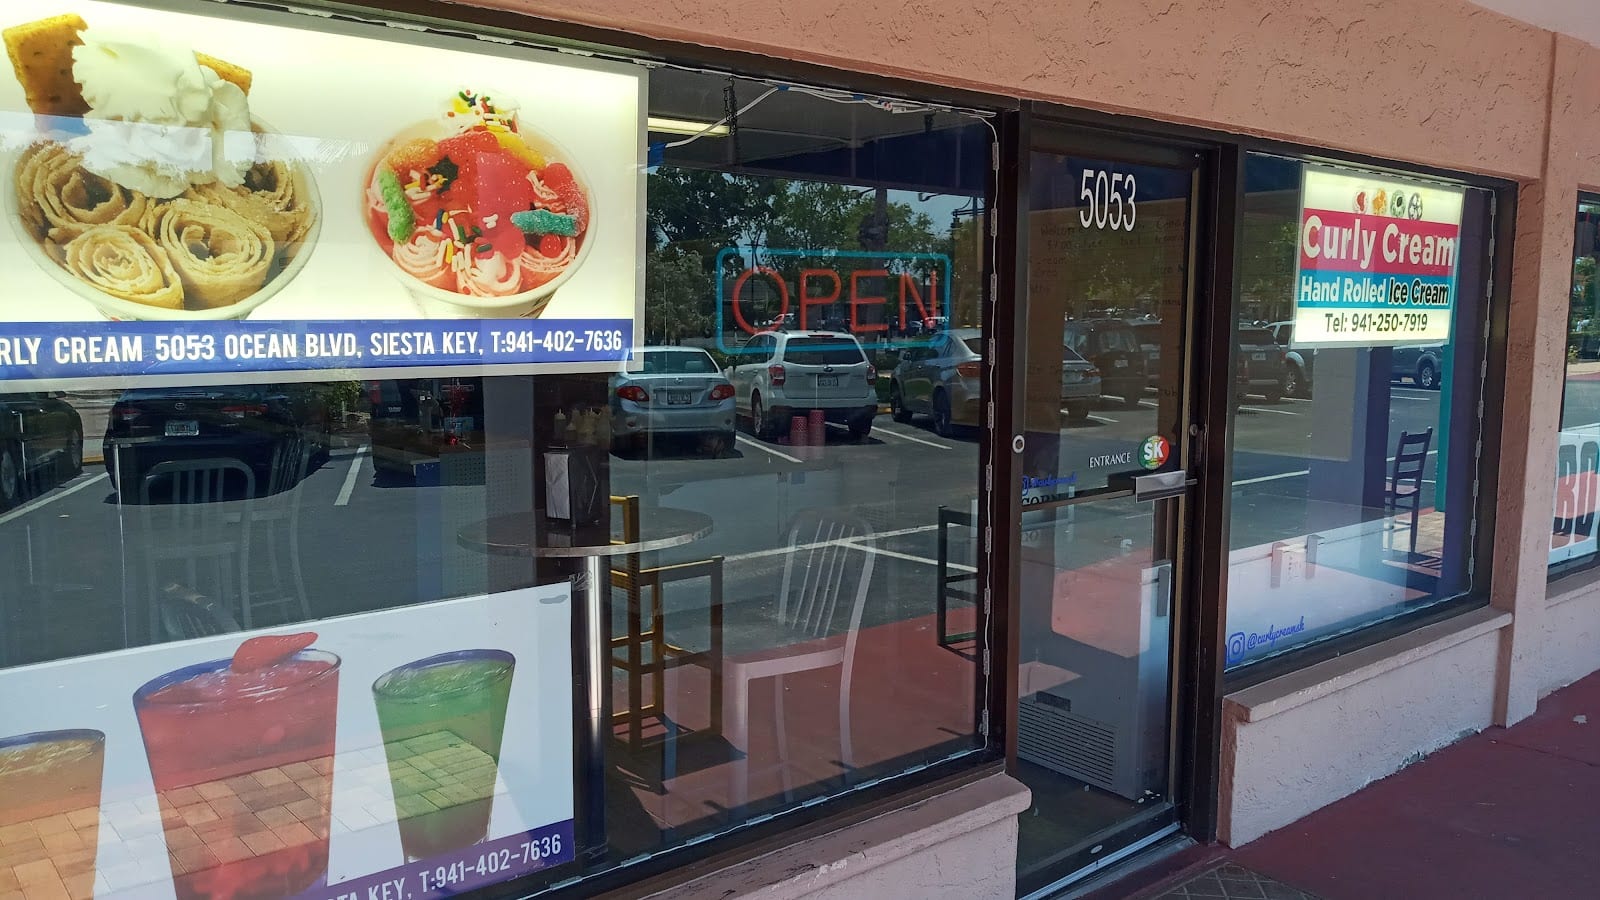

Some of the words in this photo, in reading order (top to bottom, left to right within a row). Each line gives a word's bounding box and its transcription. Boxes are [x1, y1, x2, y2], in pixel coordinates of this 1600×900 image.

[1079, 168, 1137, 232] 5053
[1302, 214, 1377, 270] Curly
[1382, 223, 1456, 267] Cream
[732, 265, 938, 336] OPEN
[1300, 275, 1341, 303] Hand
[1343, 277, 1387, 304] Rolled
[1388, 276, 1408, 305] Ice
[1410, 277, 1450, 306] Cream
[1324, 312, 1348, 333] Tel:
[1351, 313, 1429, 332] 941-250-7919
[54, 335, 144, 365] CREAM
[155, 334, 216, 362] 5053
[224, 333, 298, 360] OCEAN
[305, 332, 363, 359] BLVD,
[370, 331, 436, 356] SIESTA
[442, 331, 484, 356] KEY,
[491, 330, 623, 353] T:941-402-7636
[1088, 452, 1132, 469] ENTRANCE
[418, 832, 563, 892] T:941-402-7636
